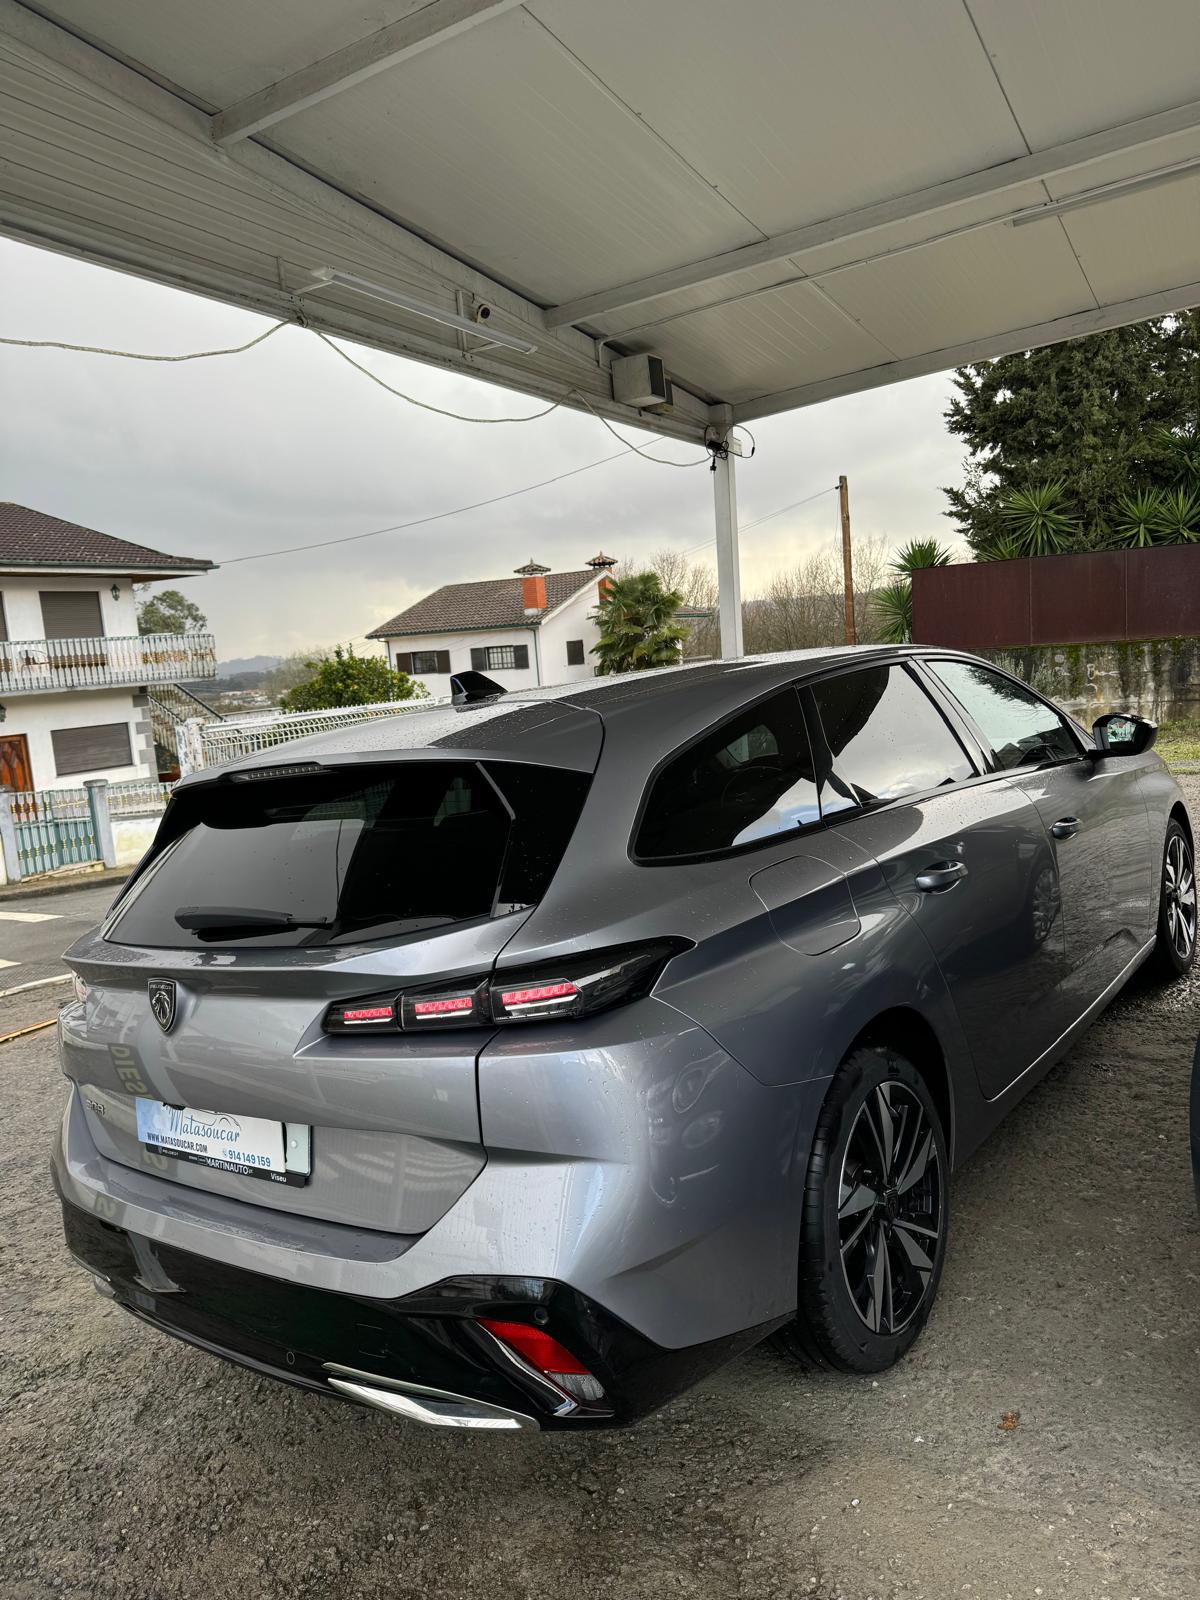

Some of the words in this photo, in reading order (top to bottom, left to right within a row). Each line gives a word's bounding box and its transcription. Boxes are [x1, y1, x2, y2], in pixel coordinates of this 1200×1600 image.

[167, 1106, 240, 1142] Matasoucar
[146, 1131, 208, 1153] WWW.MATASOUCAR.COM
[206, 1157, 249, 1175] MARTINAUTO
[270, 1172, 287, 1183] Viseu
[228, 1149, 241, 1162] 914
[242, 1152, 256, 1165] 149
[257, 1155, 271, 1168] 159
